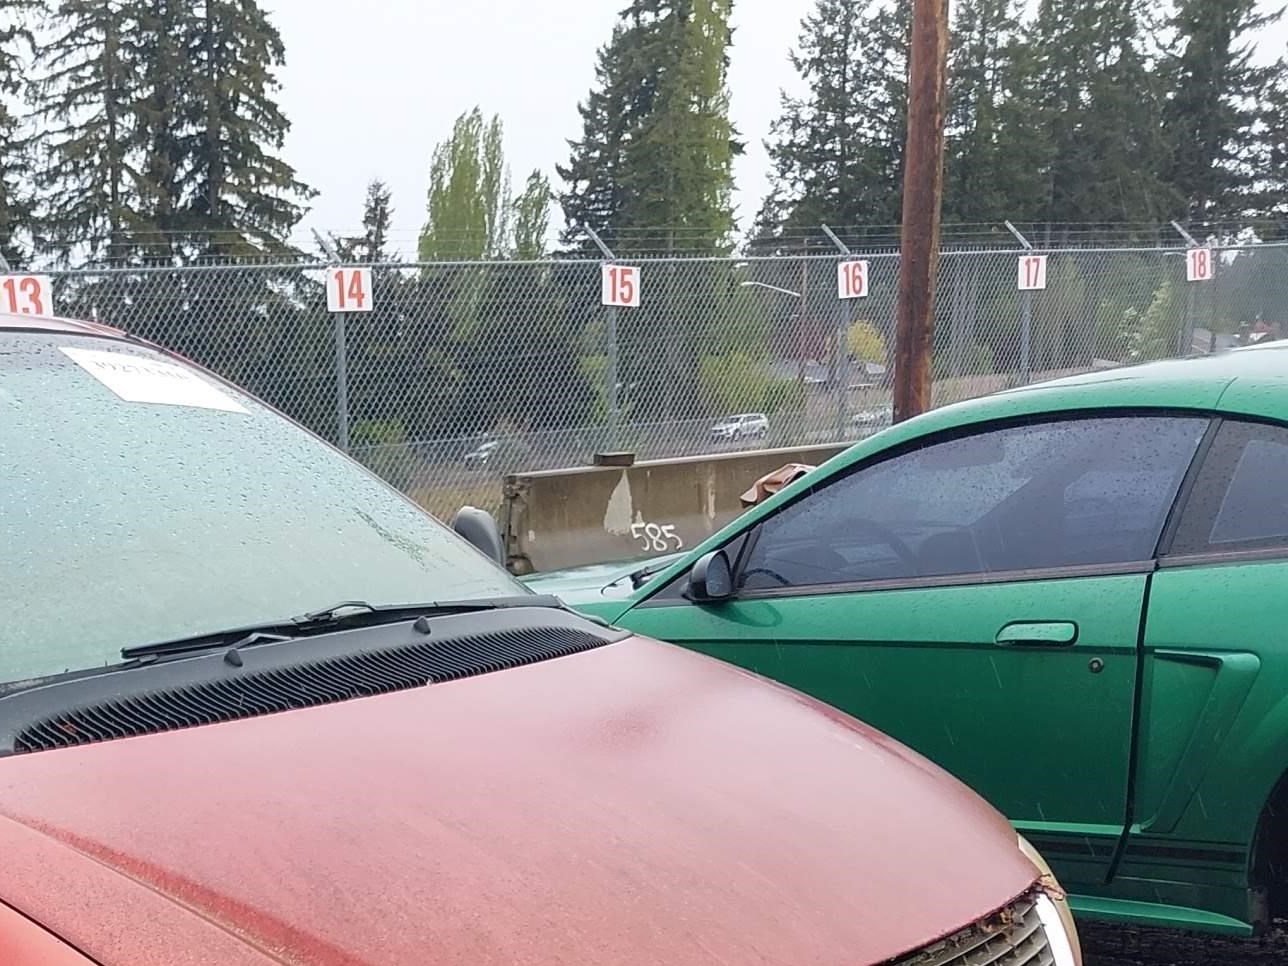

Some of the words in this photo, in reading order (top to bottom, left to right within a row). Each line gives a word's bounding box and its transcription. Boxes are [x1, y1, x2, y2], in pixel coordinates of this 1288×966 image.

[843, 262, 863, 296] 16
[1024, 257, 1041, 288] 17
[1192, 250, 1207, 279] 18
[2, 277, 44, 315] 13
[334, 270, 365, 309] 14
[609, 267, 634, 304] 15
[630, 522, 683, 552] 585
